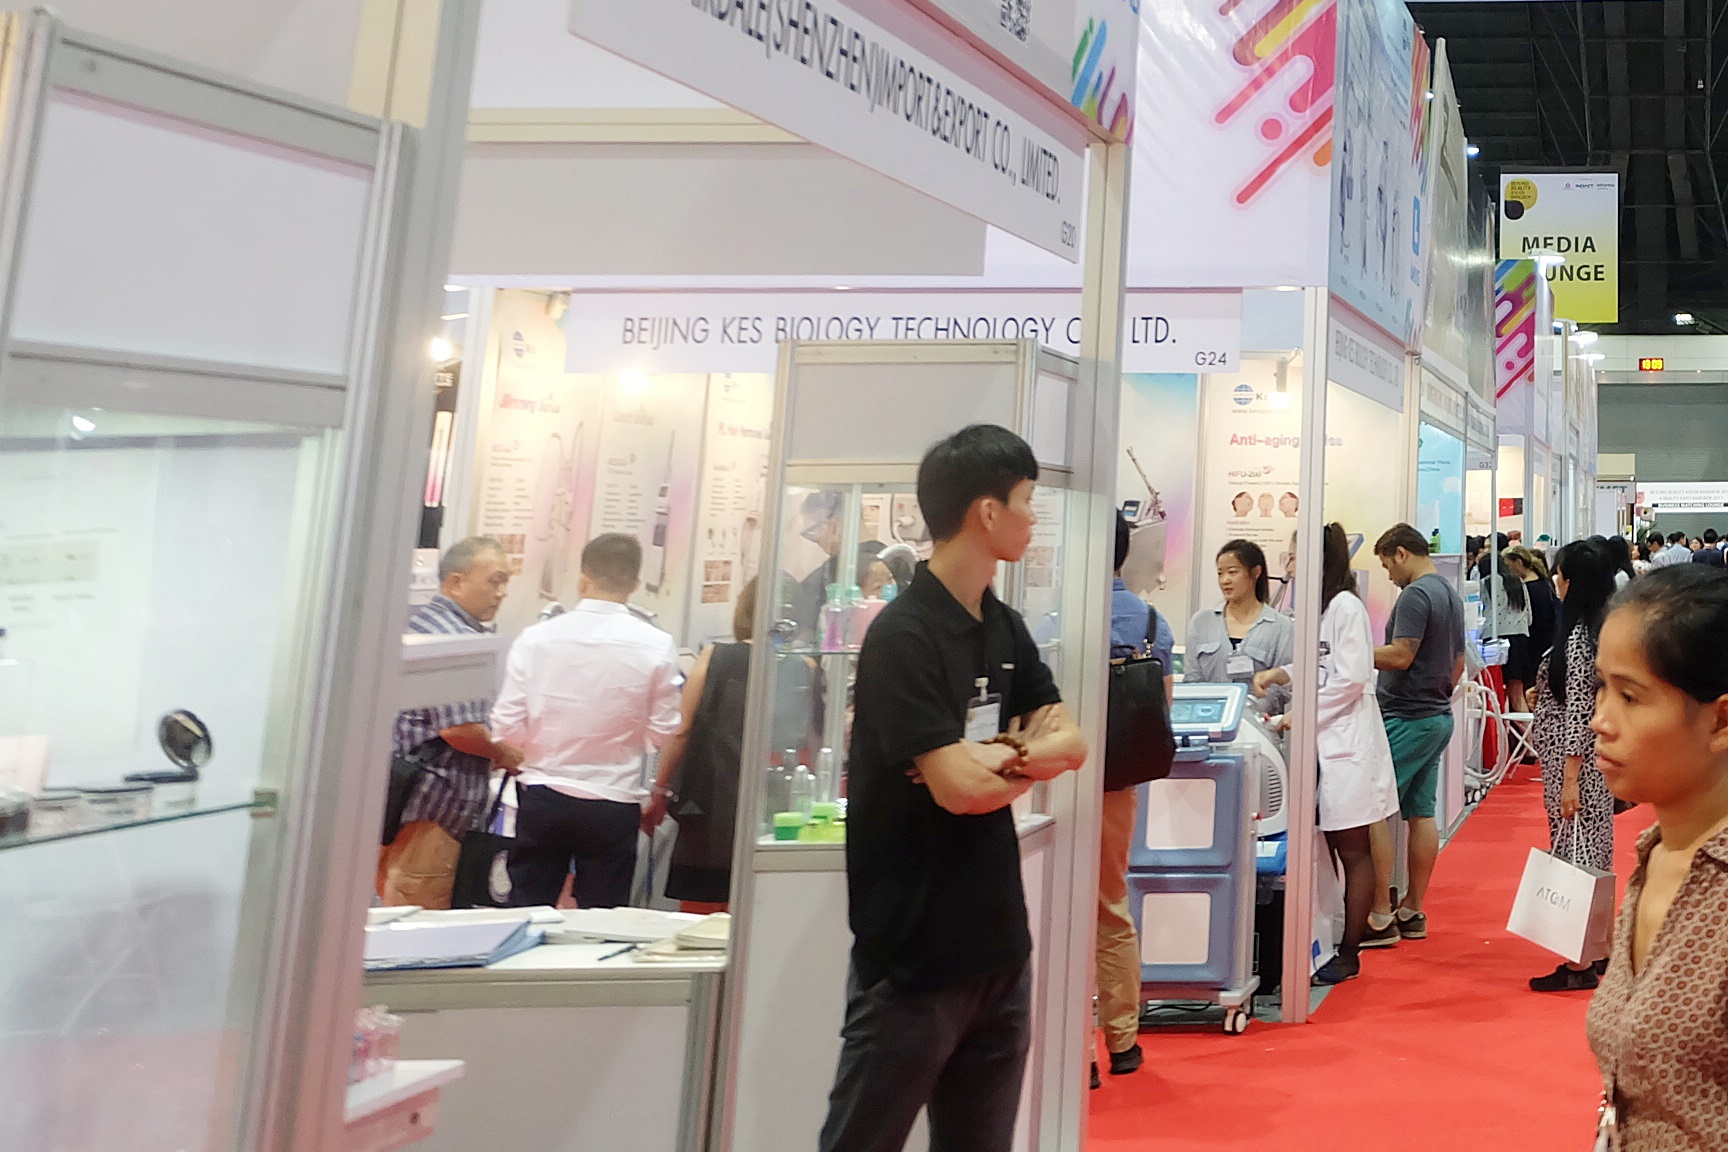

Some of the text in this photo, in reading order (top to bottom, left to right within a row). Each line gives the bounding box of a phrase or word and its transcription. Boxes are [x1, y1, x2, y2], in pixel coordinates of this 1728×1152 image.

[1521, 236, 1597, 253] MEDIA
[1545, 264, 1605, 282] UNGE
[621, 316, 711, 350] BEIJING
[720, 316, 763, 345] KES
[775, 316, 881, 345] BIOLOGY
[890, 316, 1055, 345] TECHNOLOGY
[1131, 316, 1177, 345] LTD.
[1194, 351, 1228, 367] G24
[1229, 433, 1300, 448] Anti-aging
